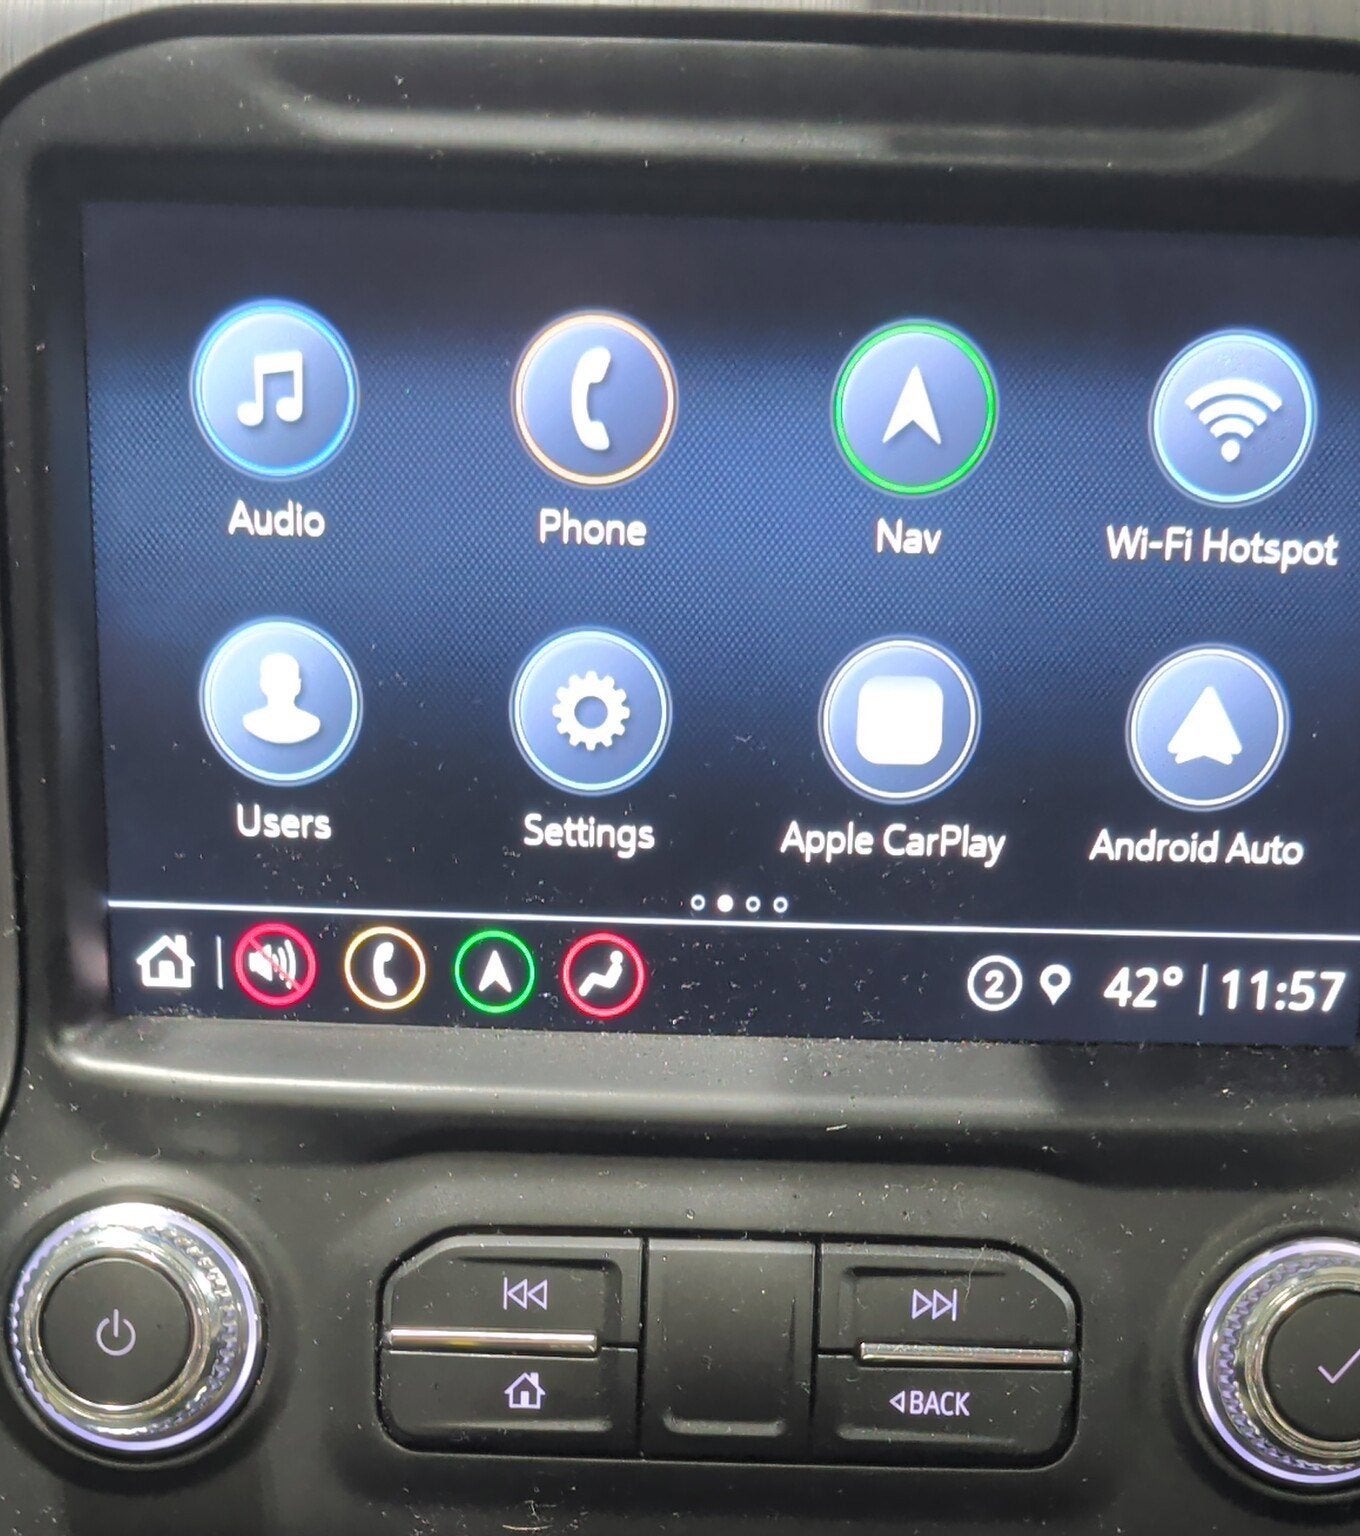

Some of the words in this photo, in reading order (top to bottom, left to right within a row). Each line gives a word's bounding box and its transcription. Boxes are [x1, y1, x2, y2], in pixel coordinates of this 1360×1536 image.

[227, 498, 326, 538] Audio
[539, 506, 647, 547] Phone
[876, 516, 943, 555] Nav
[1106, 523, 1194, 562] Wi-Fi
[1202, 526, 1340, 574] Hotspot
[236, 802, 332, 840] Users
[523, 812, 656, 860] Settings
[779, 819, 875, 864] Apple
[882, 822, 1007, 869] CarPlay
[1088, 827, 1221, 864] Android
[1224, 831, 1305, 866] Auto
[1221, 968, 1347, 1013] 11:57
[909, 1389, 970, 1417] BACK
